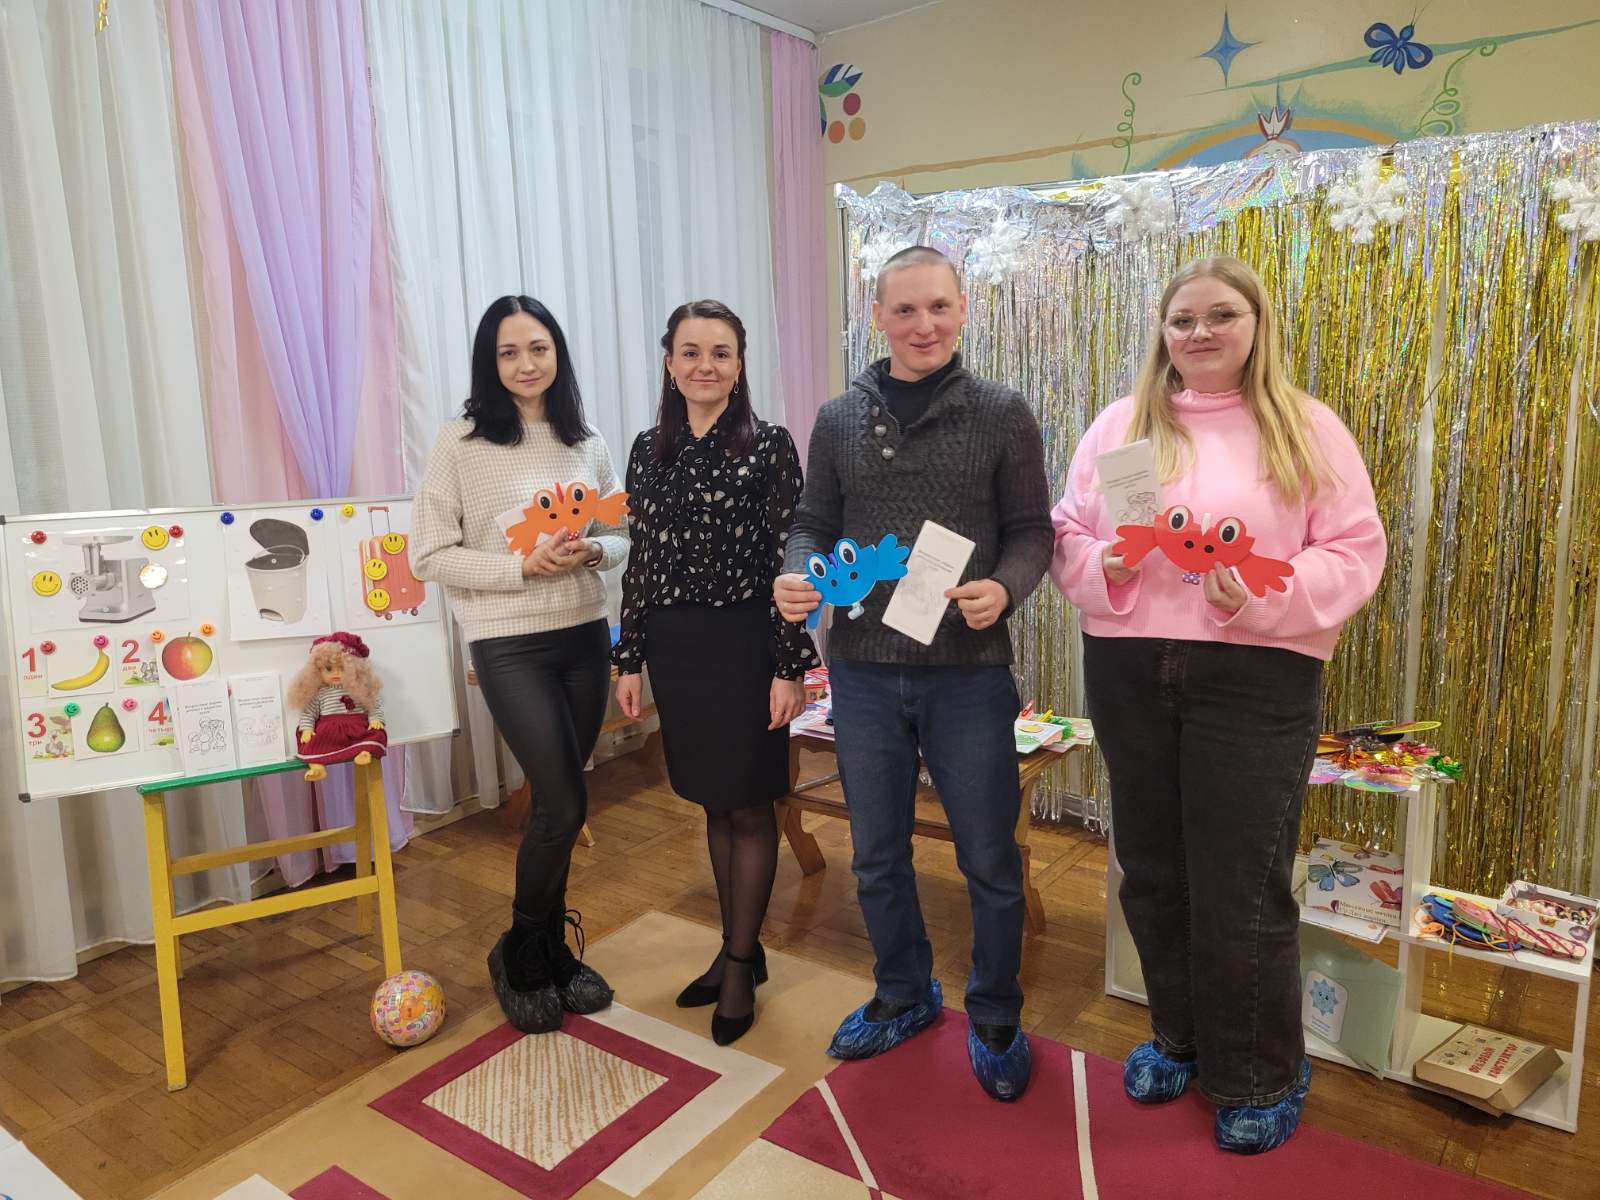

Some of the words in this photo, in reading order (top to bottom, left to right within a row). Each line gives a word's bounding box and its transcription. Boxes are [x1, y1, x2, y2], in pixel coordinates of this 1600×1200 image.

[22, 647, 36, 673] 1
[121, 639, 140, 664] 2
[148, 700, 168, 725] 4
[27, 712, 47, 739] 3
